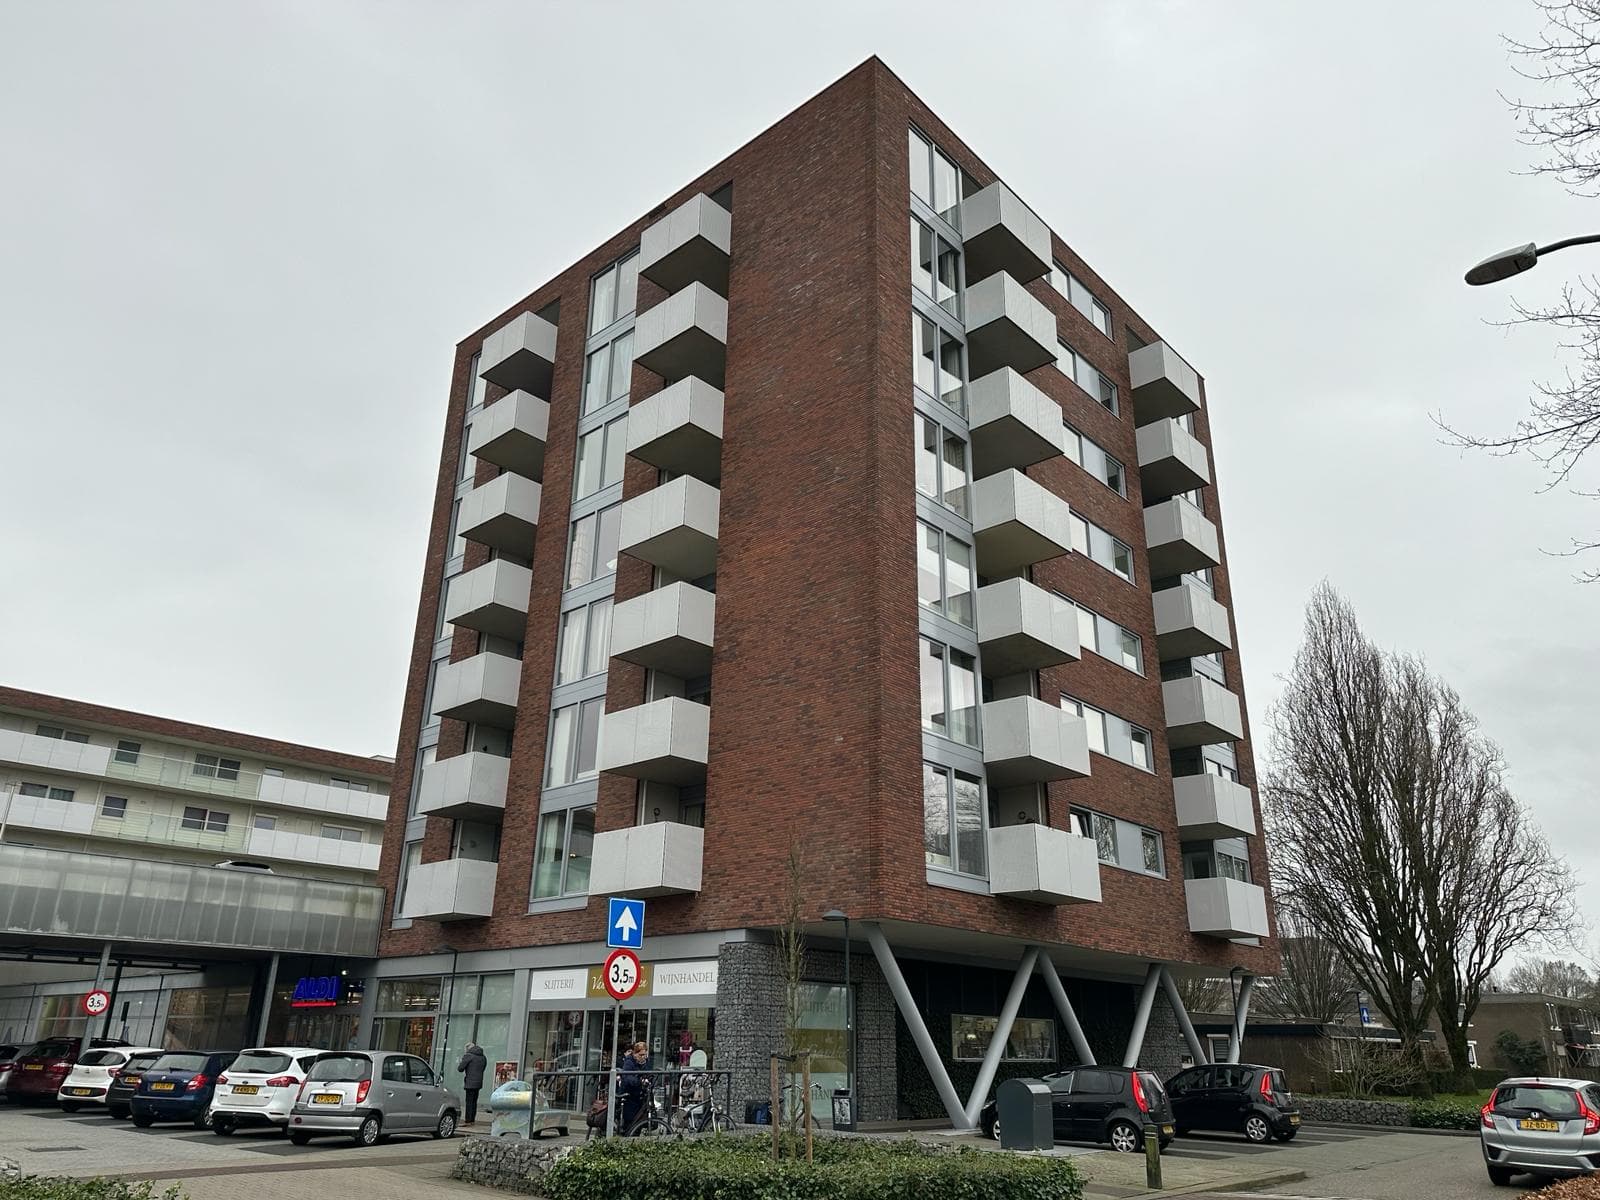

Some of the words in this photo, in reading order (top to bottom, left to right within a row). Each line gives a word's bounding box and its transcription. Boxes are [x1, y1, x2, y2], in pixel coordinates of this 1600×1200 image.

[543, 978, 575, 991] SLIJTERIJ
[659, 971, 715, 986] WIJNHANDEL
[292, 976, 337, 1000] ALDI
